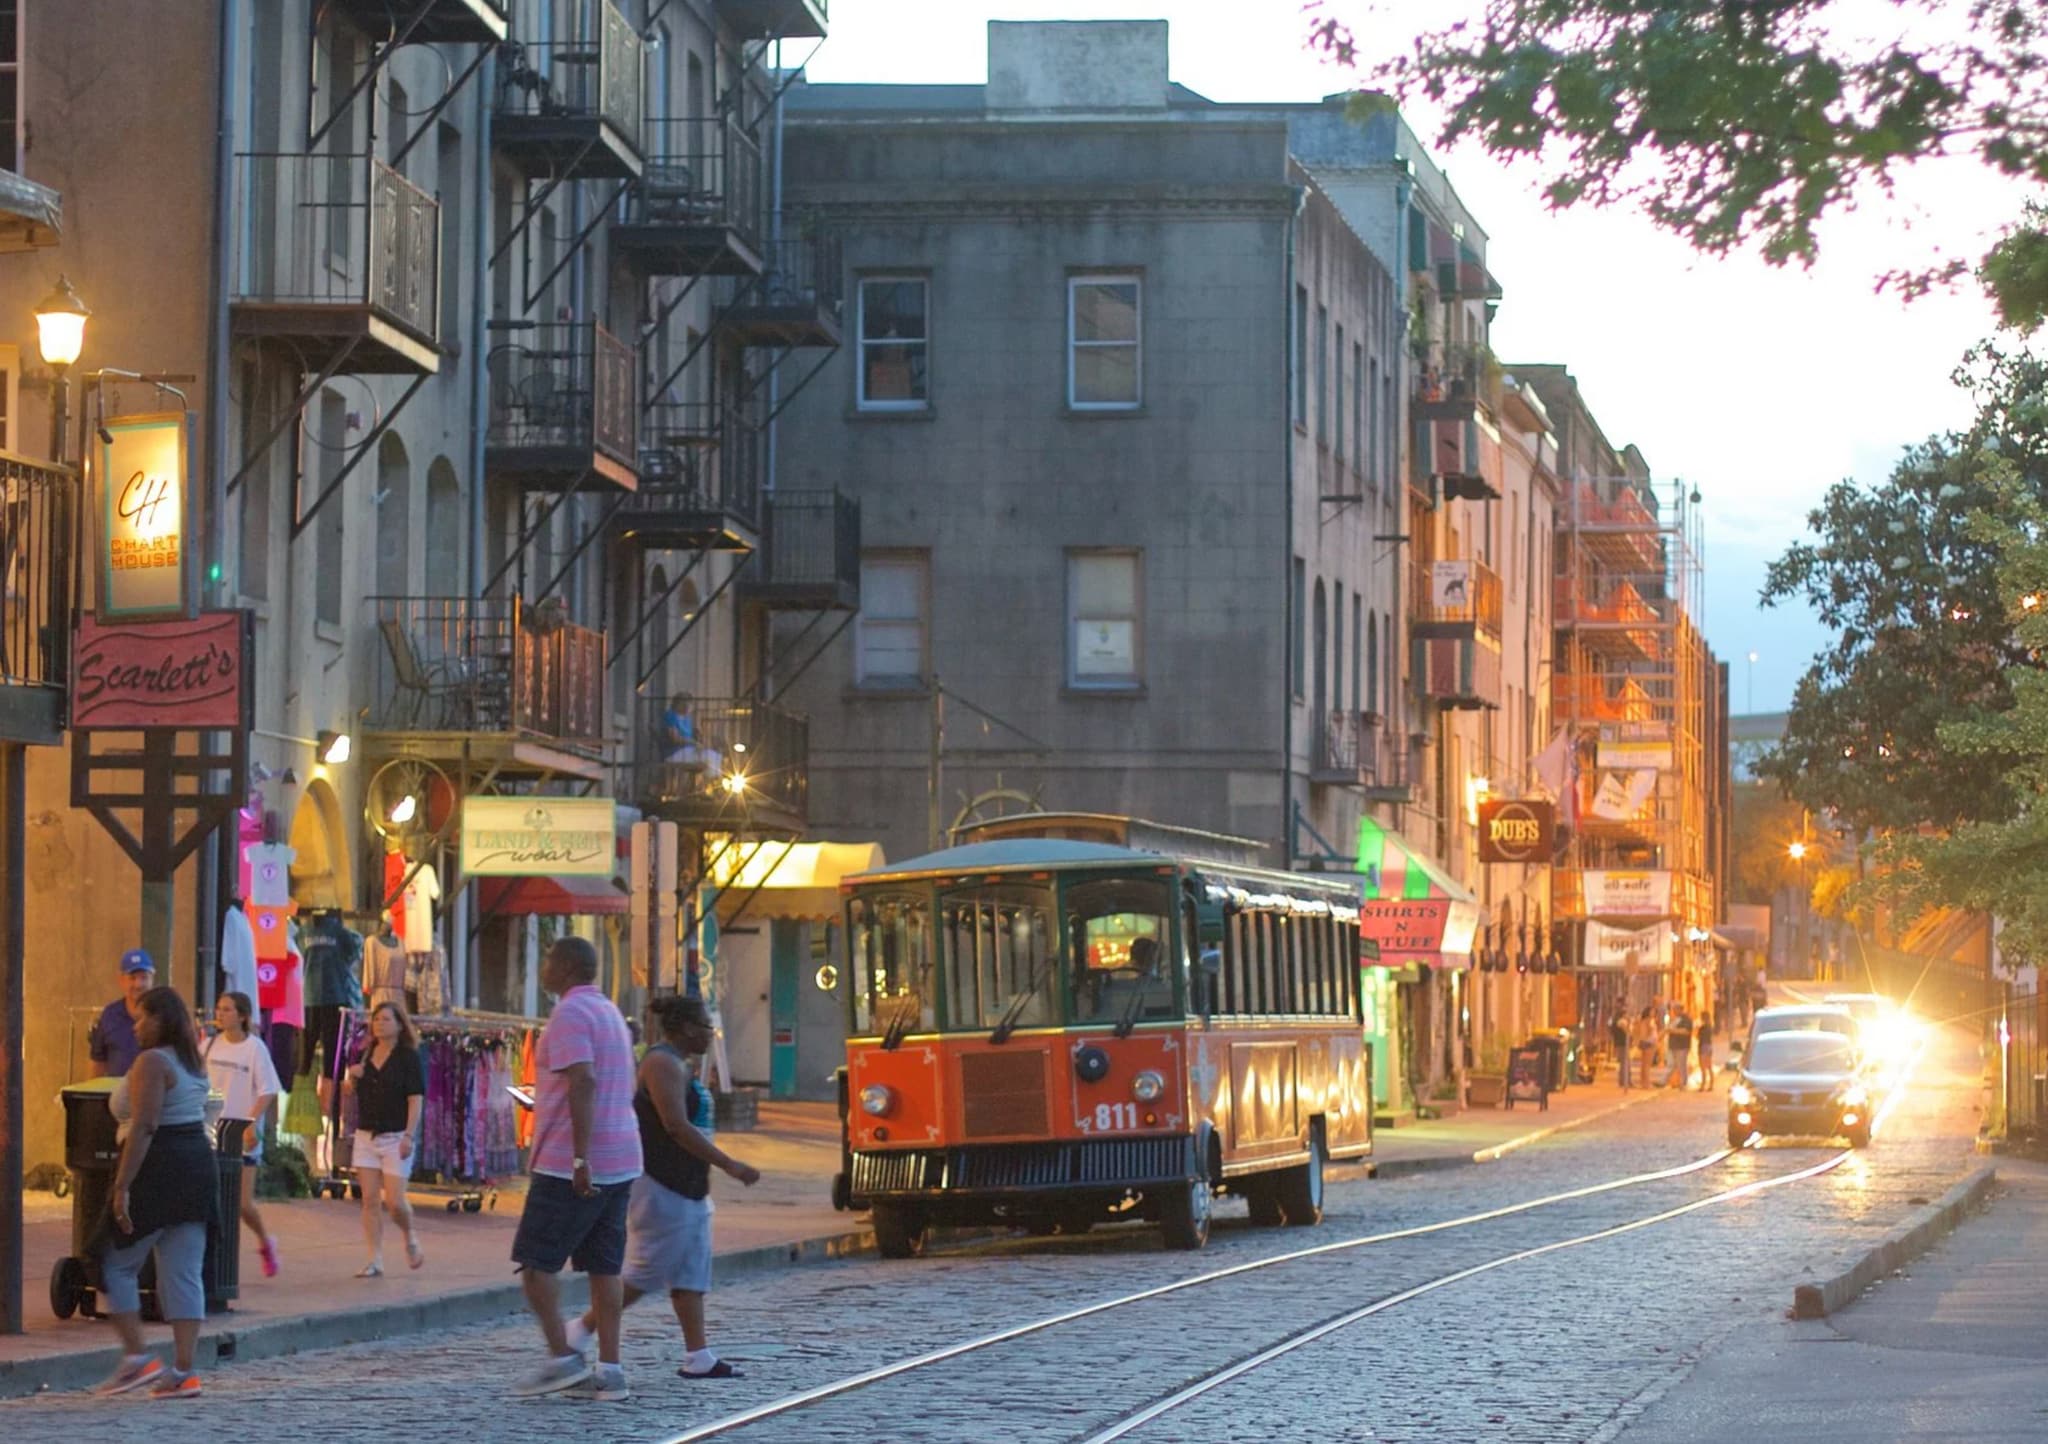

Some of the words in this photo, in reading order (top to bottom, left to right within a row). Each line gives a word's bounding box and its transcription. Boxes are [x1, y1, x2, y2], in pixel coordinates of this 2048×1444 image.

[111, 535, 178, 555] CHART
[111, 551, 178, 570] HOUSE
[77, 643, 232, 704] Scarlett's
[1488, 818, 1540, 841] DUB'S
[1364, 906, 1438, 918] SHIRTS
[1376, 936, 1434, 948] TUFF
[1095, 1102, 1137, 1130] 811
